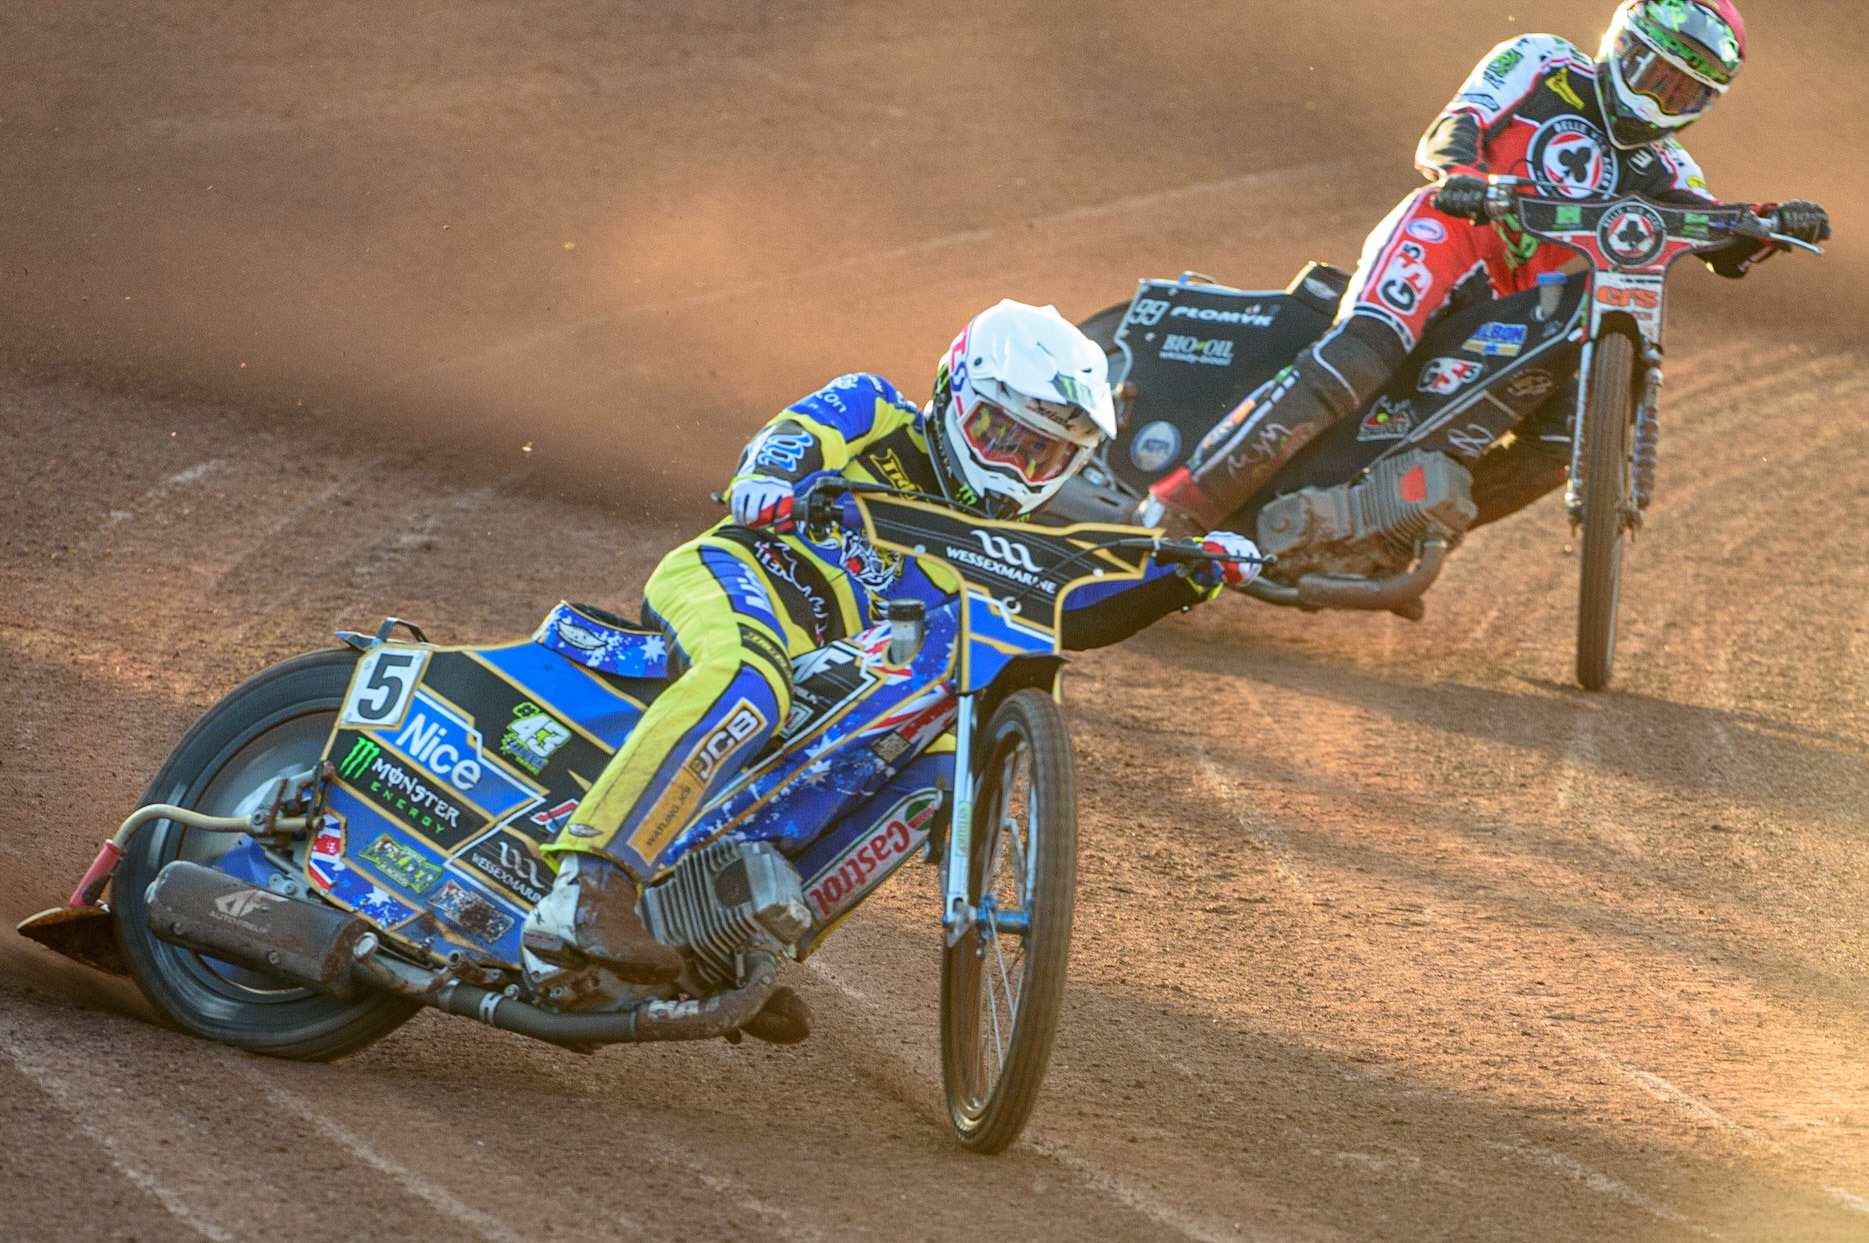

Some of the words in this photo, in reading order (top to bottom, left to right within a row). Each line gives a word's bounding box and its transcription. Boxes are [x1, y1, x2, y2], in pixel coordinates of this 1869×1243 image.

[357, 653, 414, 720] 5
[395, 713, 482, 790] Nice
[699, 709, 759, 779] JCB
[370, 780, 445, 834] ENERGY
[371, 757, 461, 828] MONSTER
[645, 804, 680, 847] WATLING
[471, 852, 543, 904] WESSEXMARIN
[810, 820, 911, 916] Castrol
